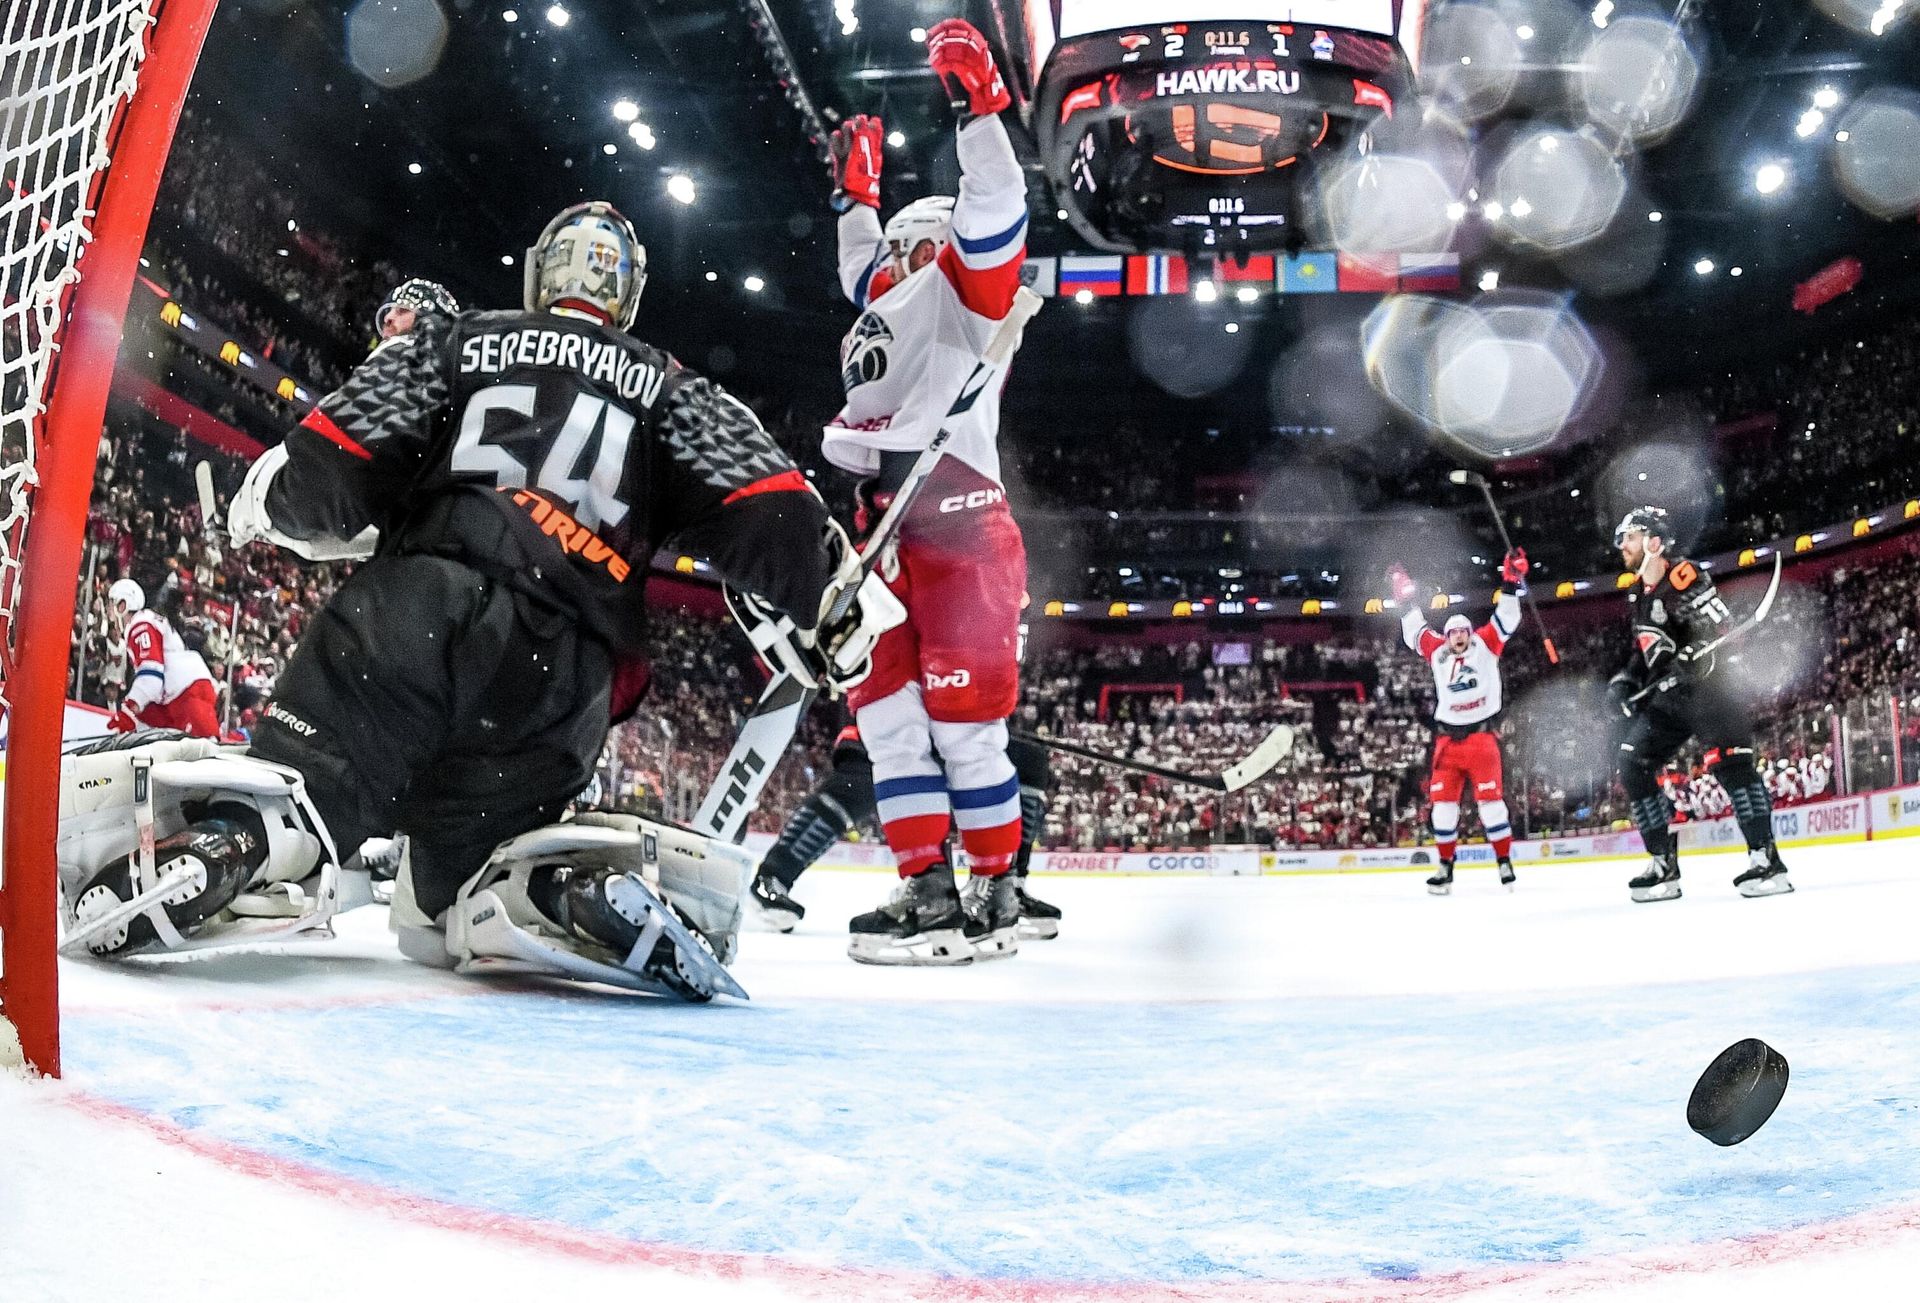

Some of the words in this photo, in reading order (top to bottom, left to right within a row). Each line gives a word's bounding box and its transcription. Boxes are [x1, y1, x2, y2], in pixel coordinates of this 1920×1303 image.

[1164, 34, 1185, 58] 2
[1272, 33, 1290, 57] 1
[1156, 69, 1300, 96] HAWK.RU
[460, 329, 665, 409] SEREBRYAKOV
[939, 488, 1003, 514] CCM
[268, 701, 318, 737] NERGY
[1807, 802, 1860, 834] FONBET
[1045, 855, 1122, 871] FONBET
